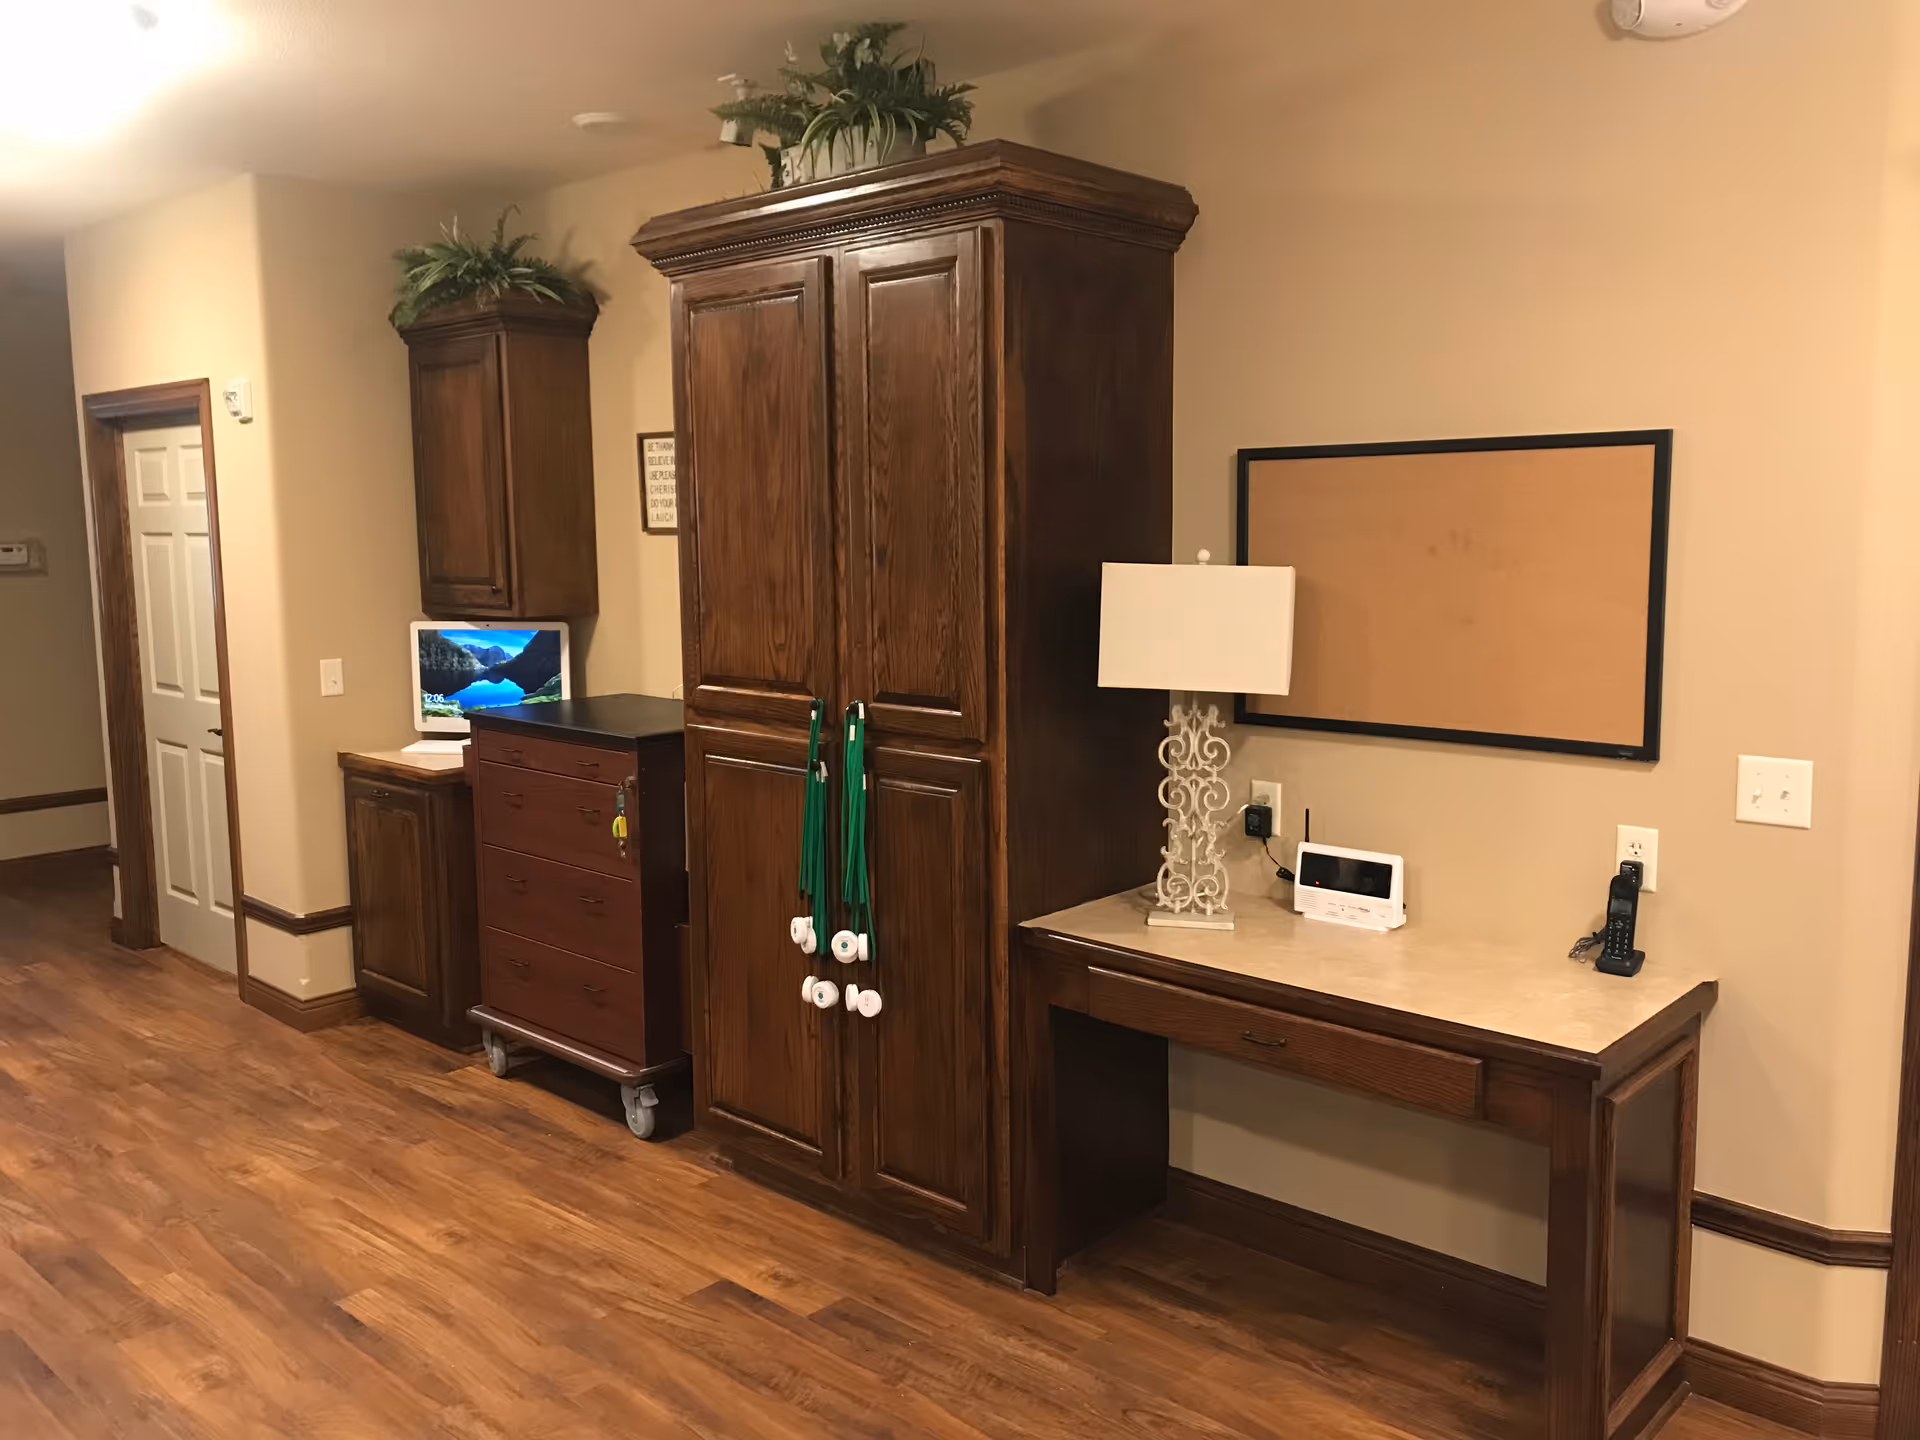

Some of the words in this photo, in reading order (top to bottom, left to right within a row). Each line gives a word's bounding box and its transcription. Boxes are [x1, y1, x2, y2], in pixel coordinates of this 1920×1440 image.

[655, 442, 674, 451] THANK
[650, 485, 675, 494] CHERIS
[423, 693, 444, 703] 12:06
